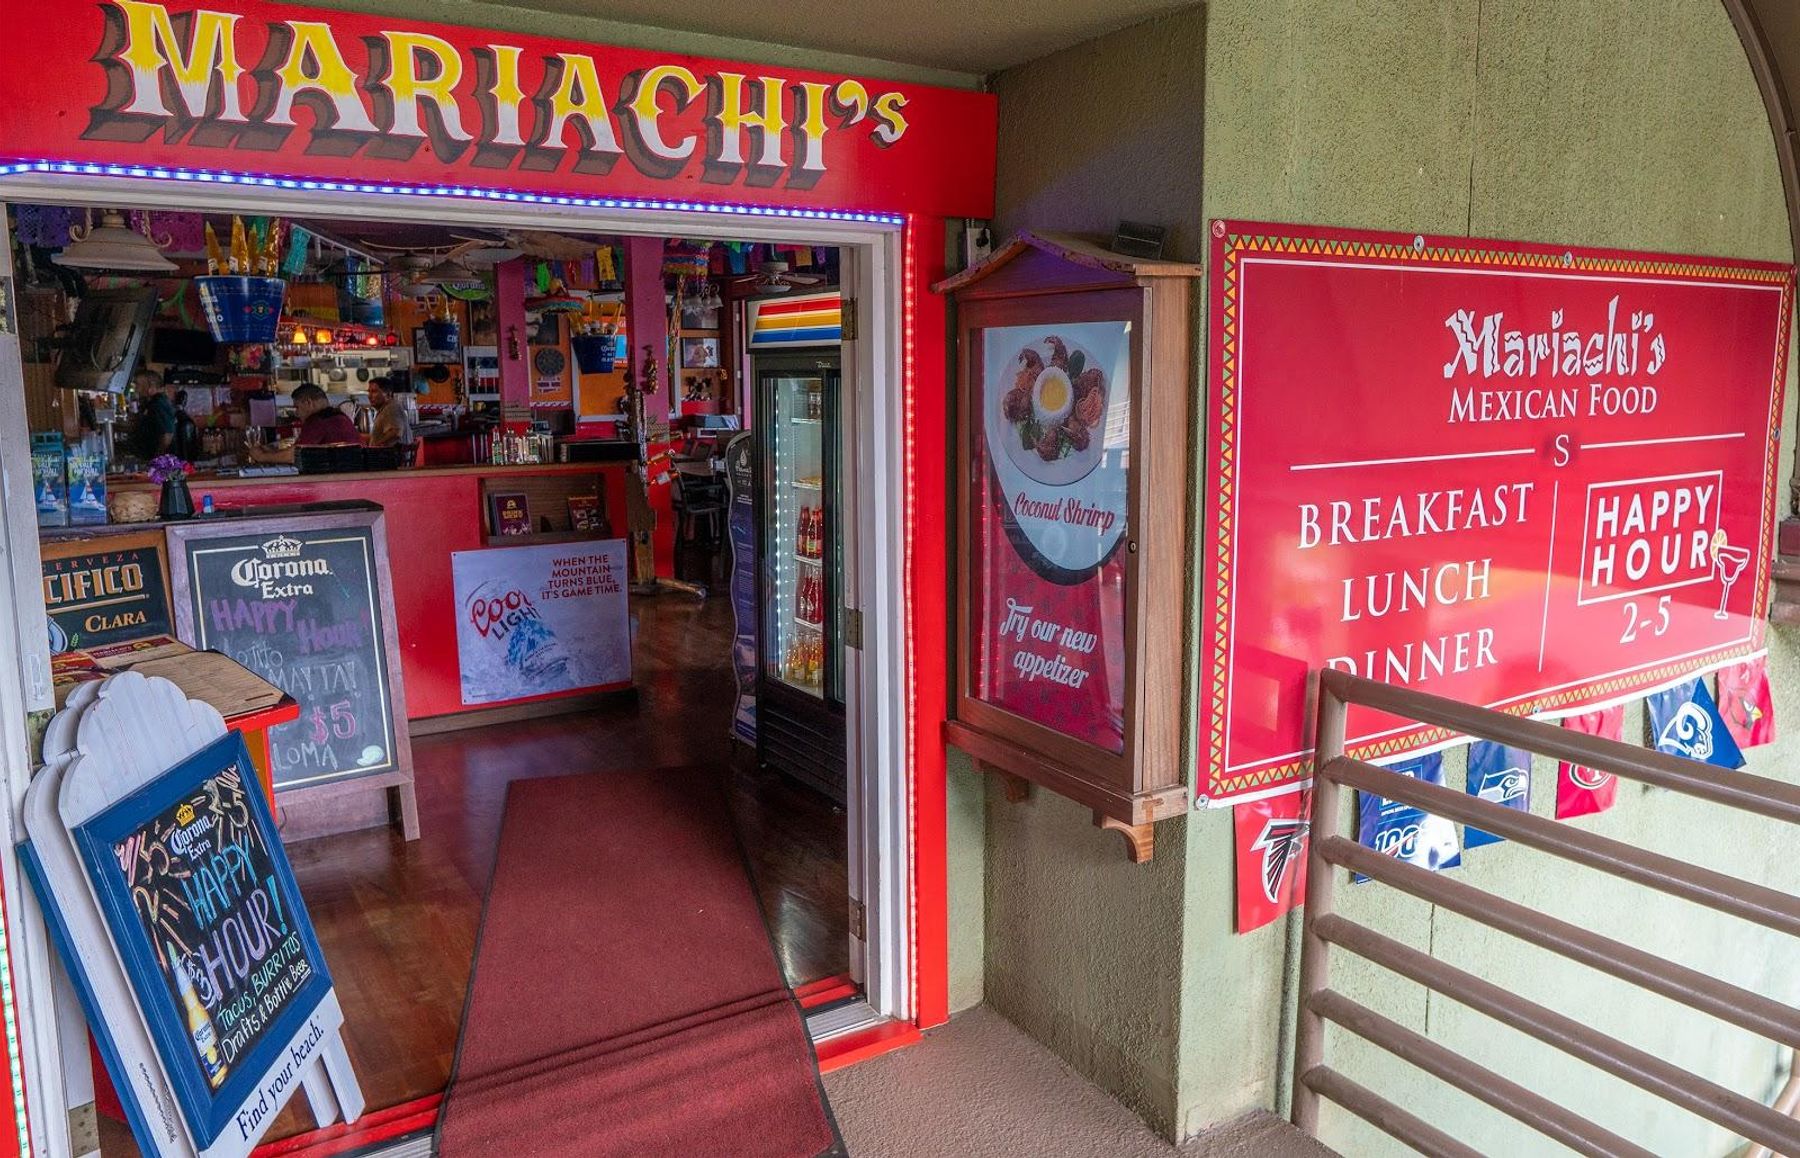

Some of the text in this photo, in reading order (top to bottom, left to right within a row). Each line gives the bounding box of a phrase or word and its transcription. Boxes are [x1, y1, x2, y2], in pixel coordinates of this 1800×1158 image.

[1443, 295, 1666, 378] Mariachi's
[1447, 383, 1658, 423] MEXICAN FOOD
[1553, 434, 1570, 467] S
[1013, 491, 1116, 537] Coconut Shrimp
[1297, 481, 1534, 549] BREAKFAST
[1595, 485, 1714, 539] HAPPY
[231, 557, 330, 588] Corona
[551, 565, 611, 578] MOUNTAIN
[552, 554, 609, 567] WHEN THE
[1591, 530, 1709, 588] HOUR
[262, 581, 314, 599] Extra
[548, 577, 584, 589] TURNS
[561, 586, 593, 598] GAME
[1340, 558, 1492, 622] LUNCH
[85, 610, 147, 633] CLARA
[211, 599, 298, 634] HAPPY
[1000, 597, 1098, 654] Try our new
[1619, 595, 1672, 644] 2-5
[1013, 649, 1090, 690] appetizer
[309, 699, 356, 745] $5
[272, 741, 338, 771] LOMA
[171, 815, 215, 855] Corona
[187, 839, 212, 861] Extra
[181, 831, 258, 930] HAPPY
[236, 1086, 269, 1142] Find
[267, 1061, 294, 1112] your
